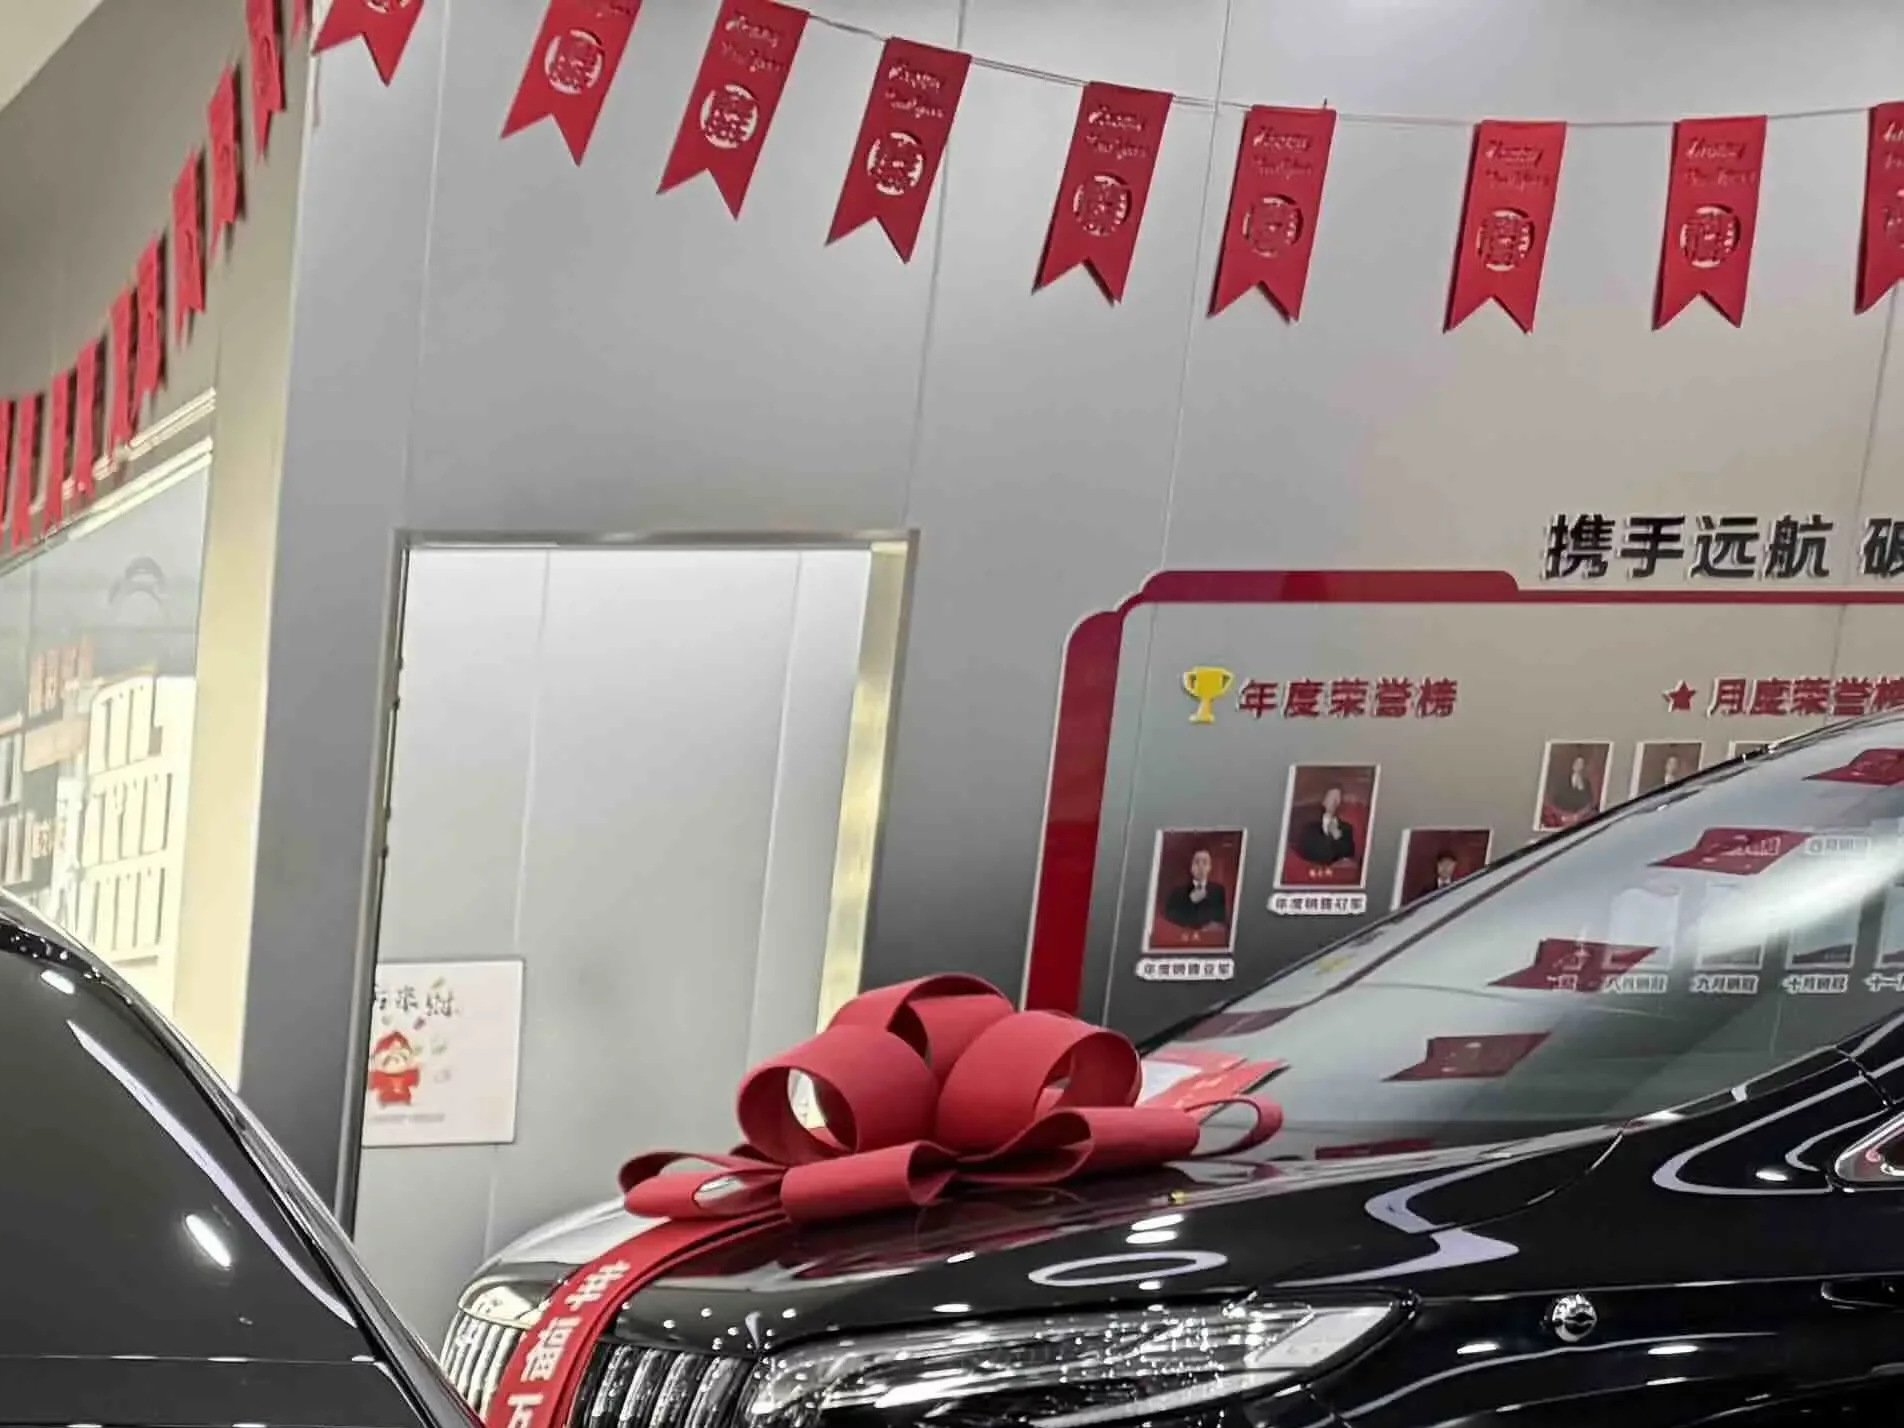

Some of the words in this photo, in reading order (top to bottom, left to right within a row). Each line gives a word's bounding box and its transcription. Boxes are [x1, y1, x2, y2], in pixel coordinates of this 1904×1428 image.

[1542, 513, 1834, 580] 携手远航
[1238, 676, 1459, 719] 年度荣誉榜
